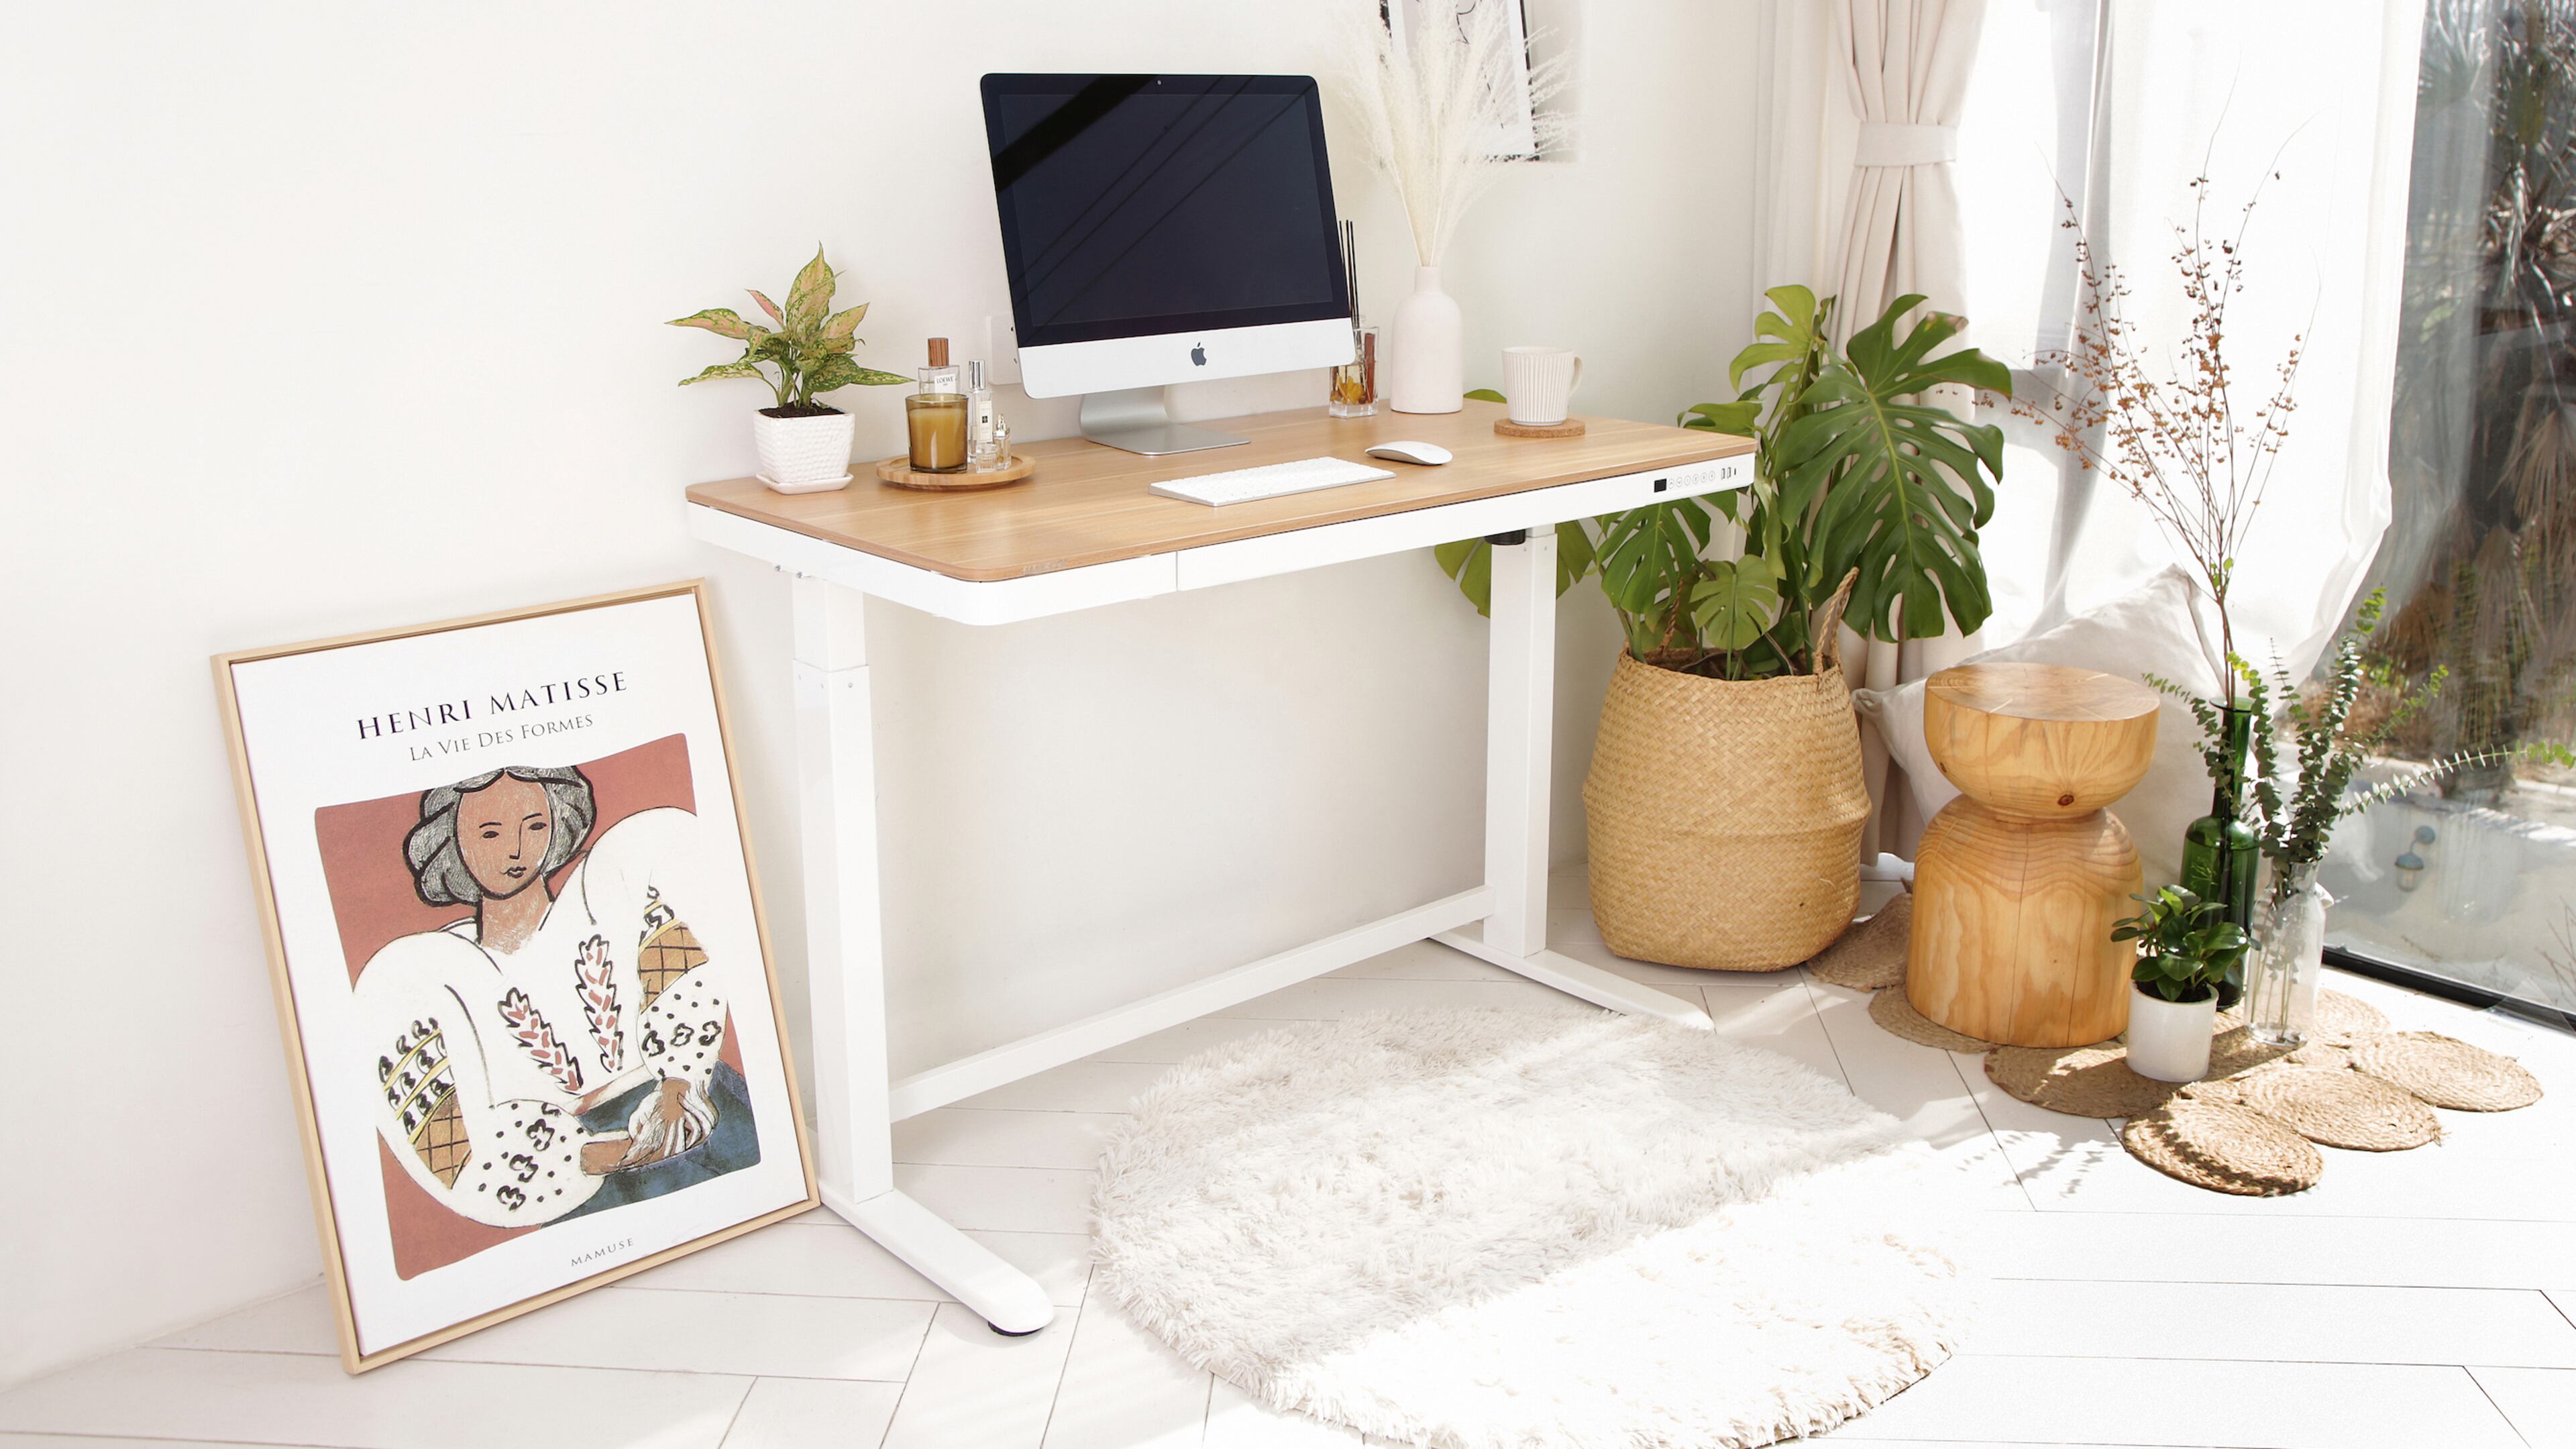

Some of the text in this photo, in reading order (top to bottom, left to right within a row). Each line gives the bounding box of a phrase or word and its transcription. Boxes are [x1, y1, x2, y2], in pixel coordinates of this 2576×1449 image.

[358, 672, 627, 739] HENRI MATISSE
[571, 1238, 634, 1267] MAMUSE
